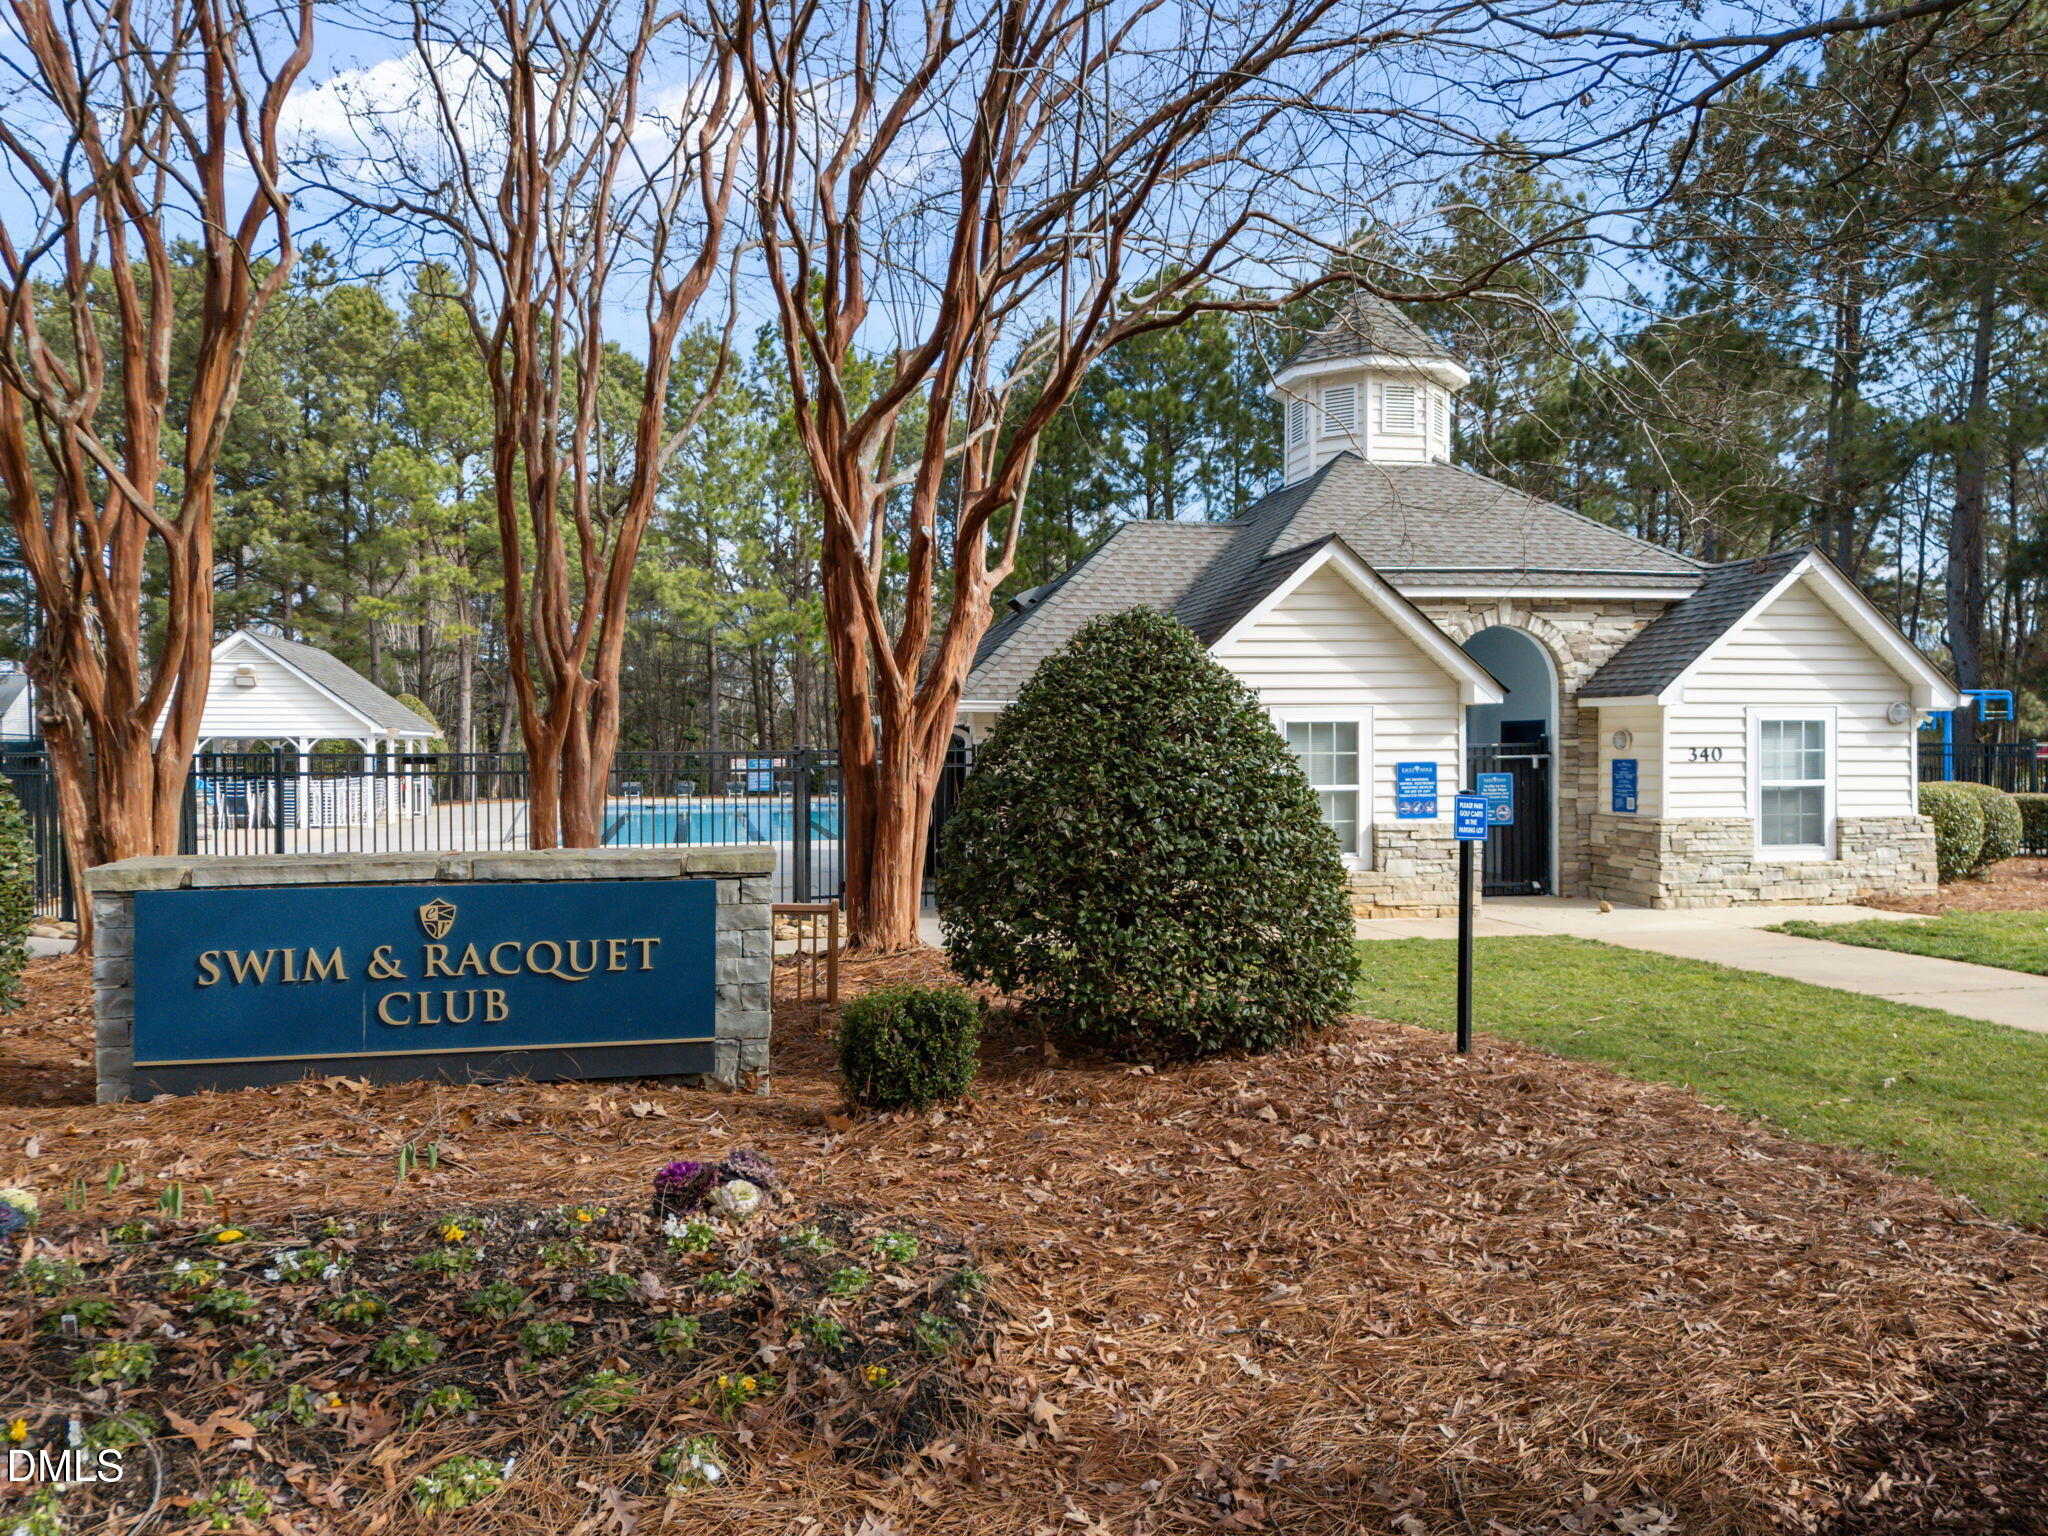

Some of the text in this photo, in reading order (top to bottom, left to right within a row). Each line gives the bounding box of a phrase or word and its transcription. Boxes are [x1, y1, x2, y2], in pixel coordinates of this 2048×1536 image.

[1688, 746, 1723, 762] 340
[198, 937, 661, 986] SWIM & RACQUET
[377, 988, 509, 1026] CLUB
